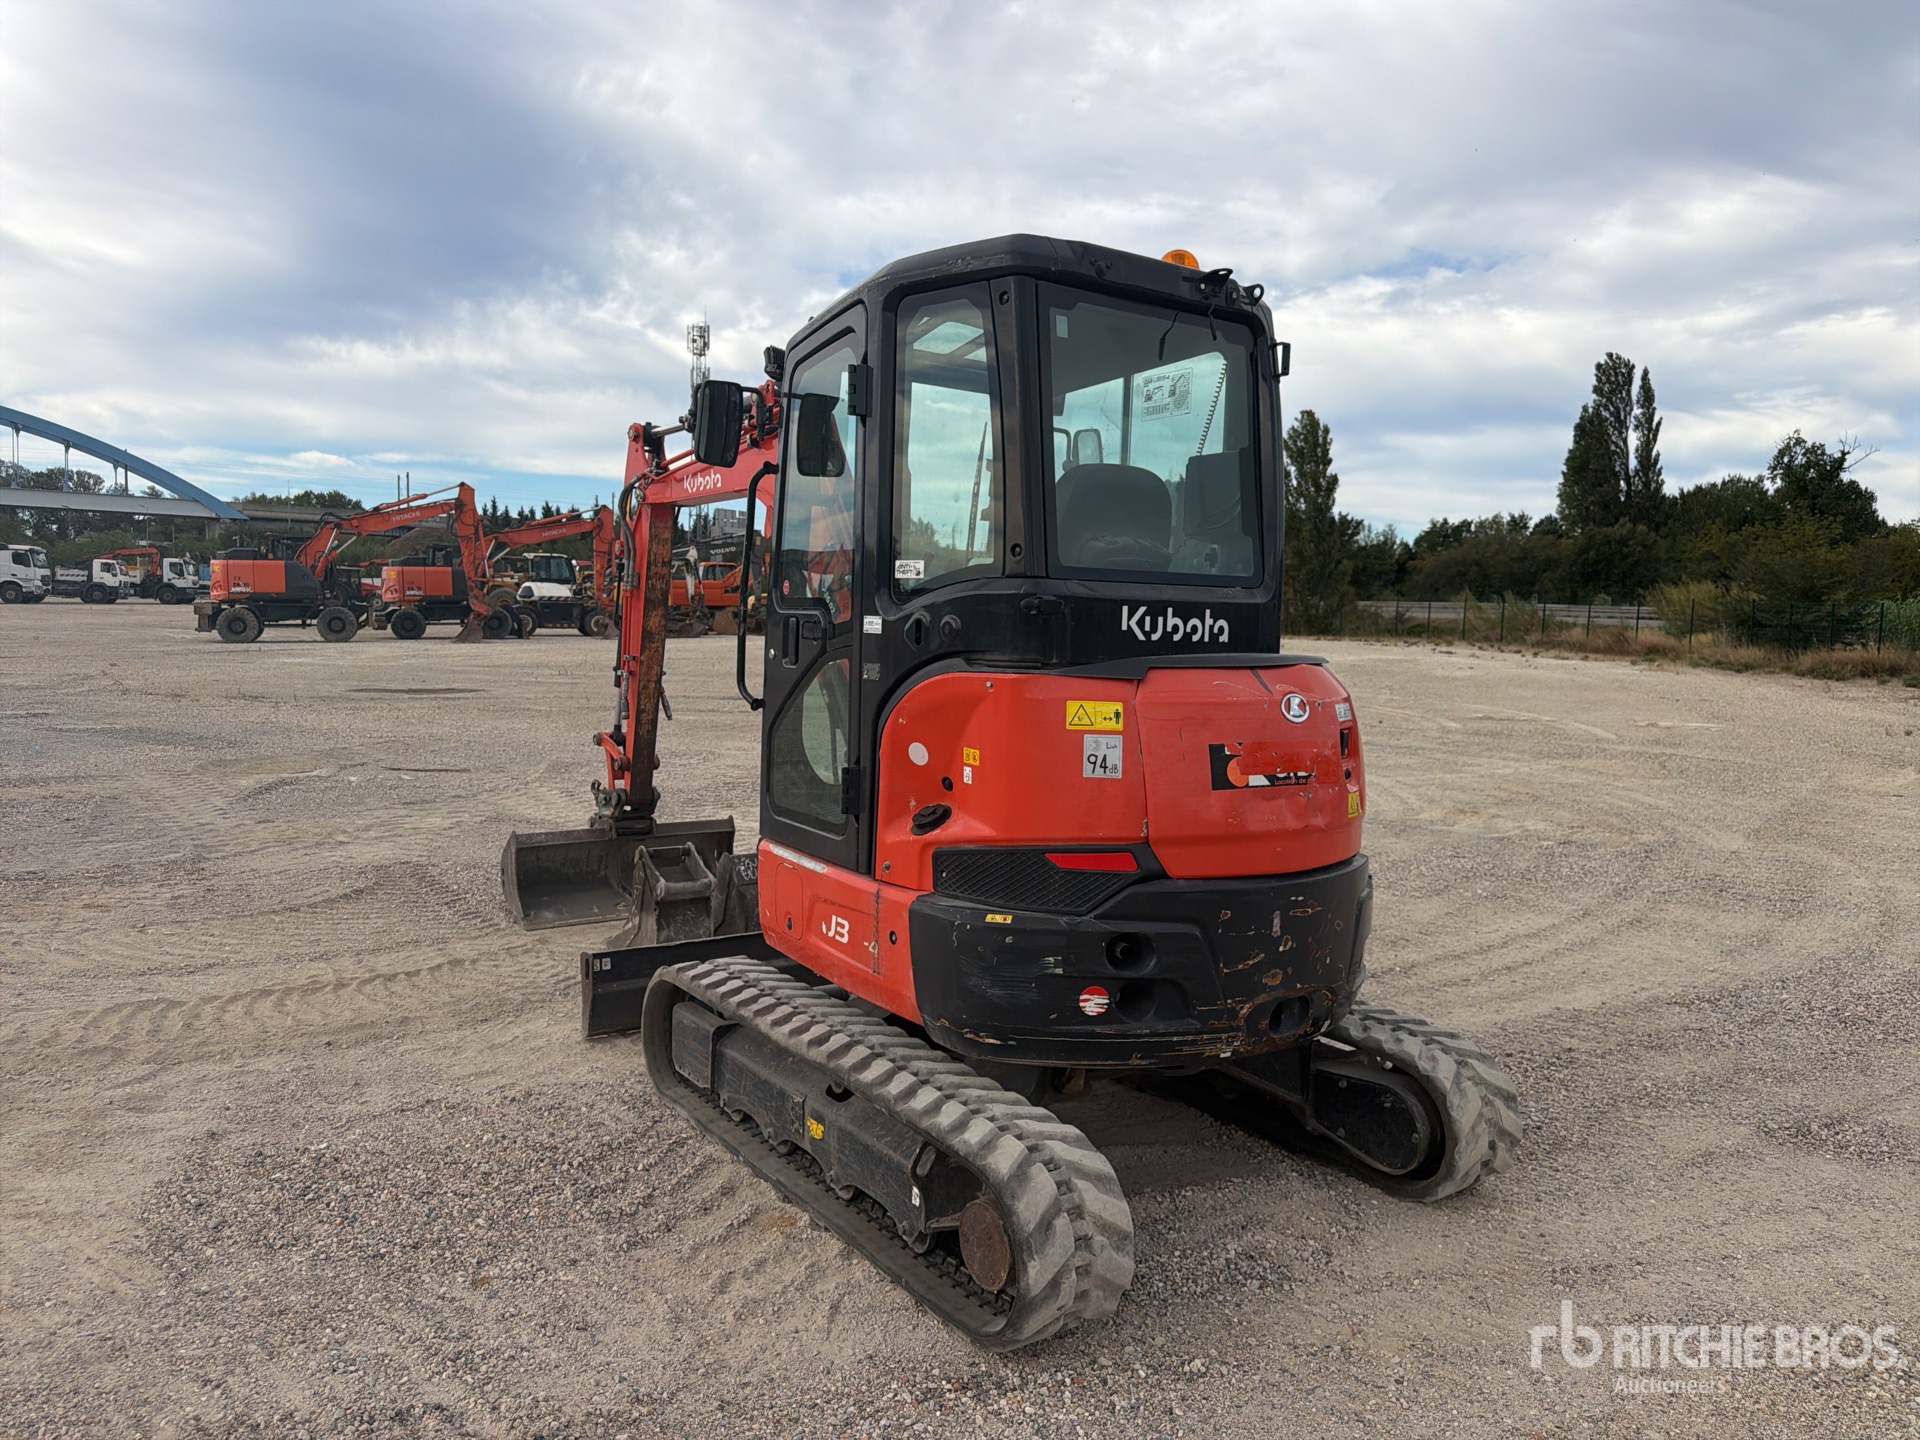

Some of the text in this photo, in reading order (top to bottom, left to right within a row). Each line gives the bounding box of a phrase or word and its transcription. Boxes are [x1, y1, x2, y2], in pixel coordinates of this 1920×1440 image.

[684, 469, 722, 493] Kubota
[710, 546, 737, 555] VOLVO
[1121, 605, 1229, 643] Kubota
[1087, 753, 1108, 775] 94
